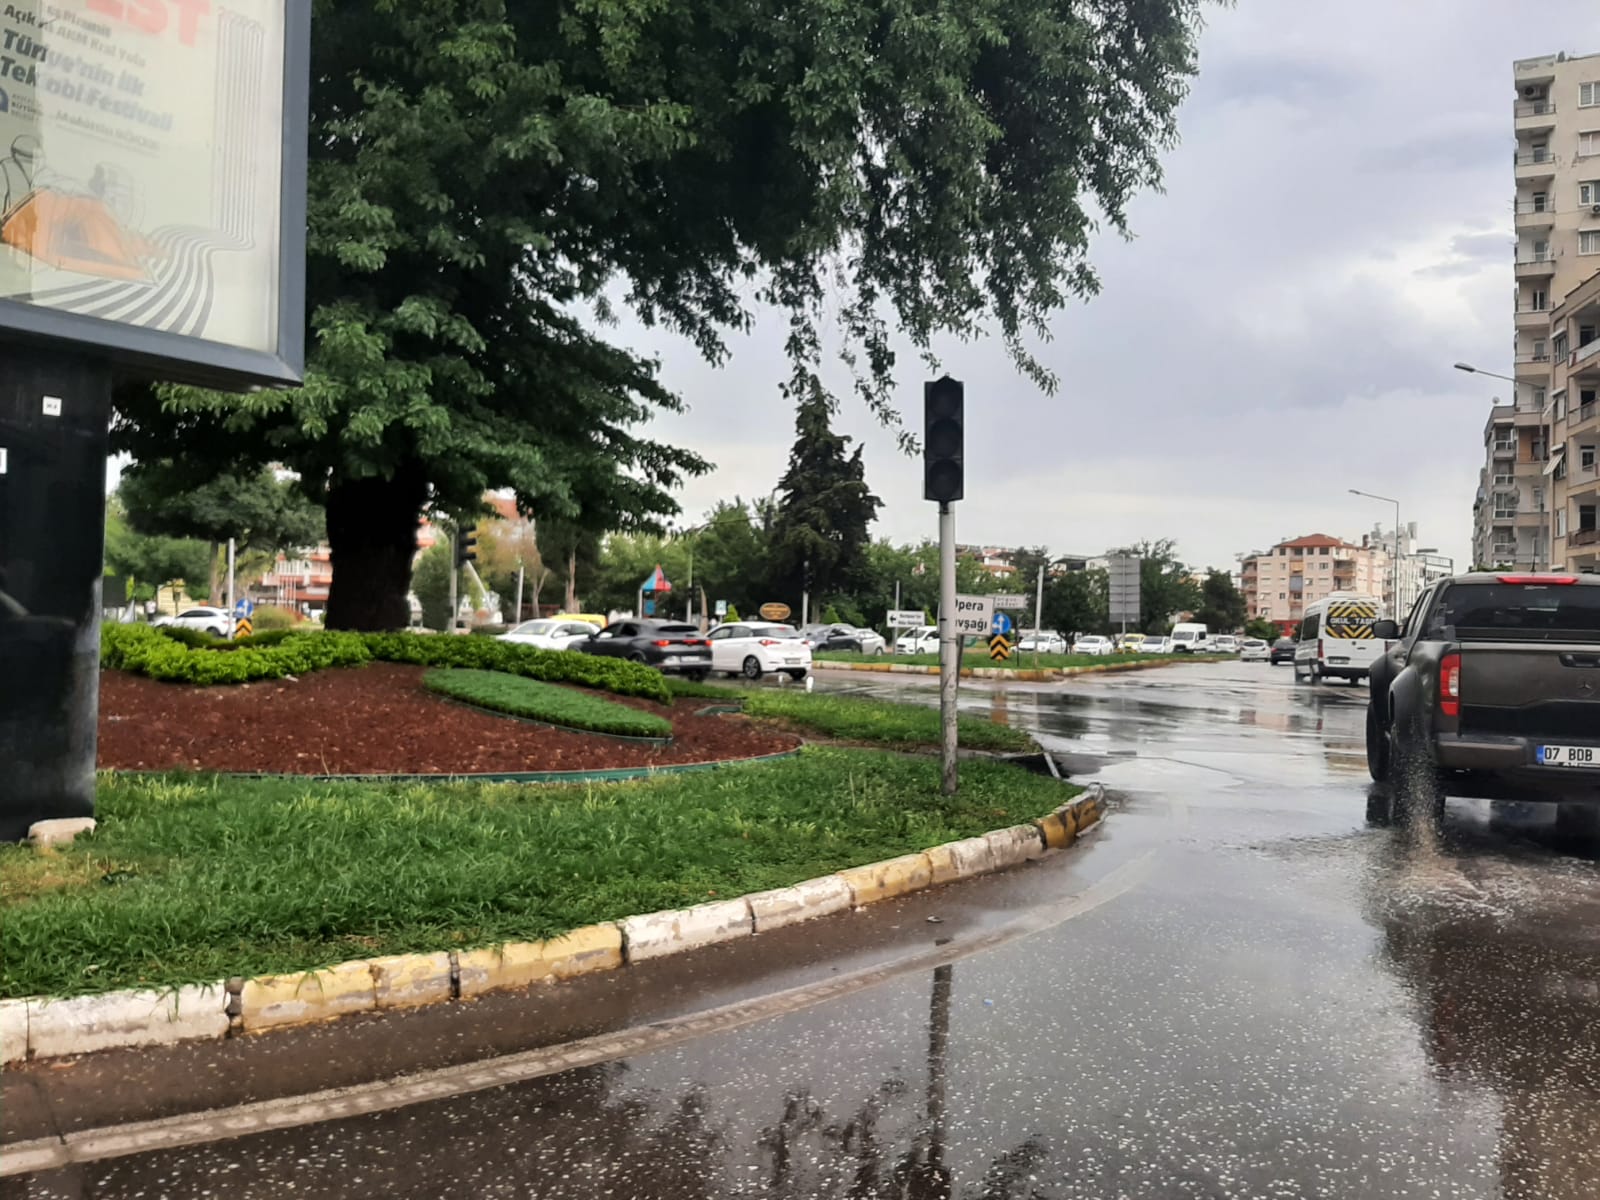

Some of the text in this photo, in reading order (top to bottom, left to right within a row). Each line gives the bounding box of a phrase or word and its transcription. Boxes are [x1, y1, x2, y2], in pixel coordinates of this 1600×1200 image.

[4, 4, 36, 25] Açık
[4, 28, 114, 87] Türye'nin
[954, 617, 988, 632] vşağı
[1545, 747, 1560, 761] 07
